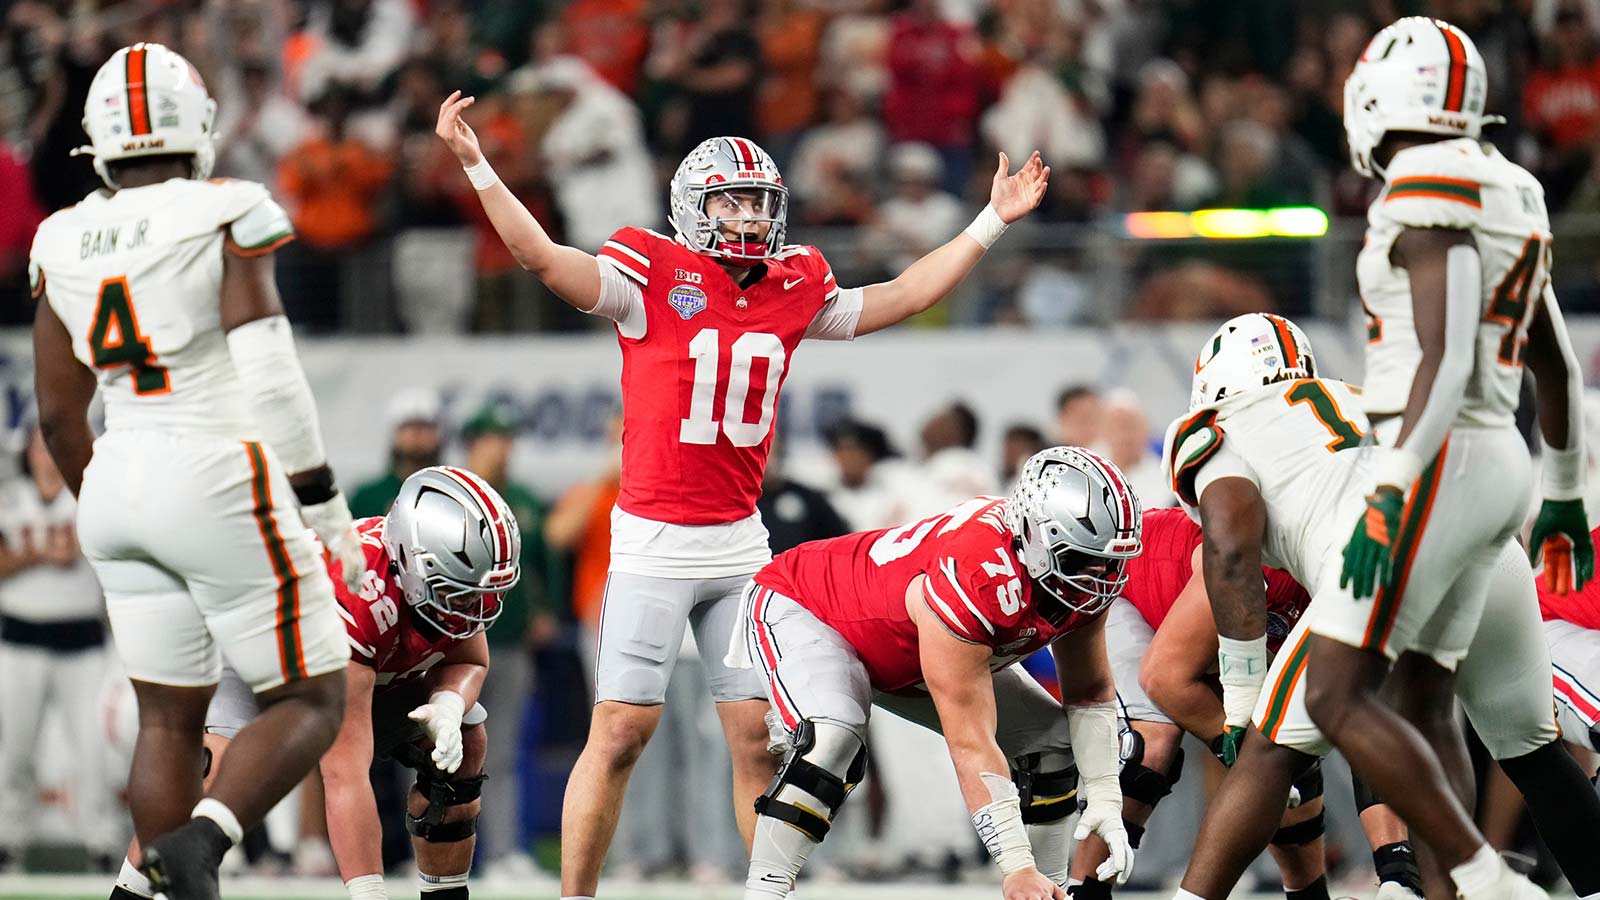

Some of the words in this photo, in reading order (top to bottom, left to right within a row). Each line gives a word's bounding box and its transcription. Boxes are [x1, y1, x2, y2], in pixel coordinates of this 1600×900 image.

[122, 138, 165, 151] MIAMI
[1428, 115, 1467, 130] MIAMI
[80, 228, 121, 260] BAIN
[87, 273, 173, 397] 4
[679, 327, 786, 448] 10
[358, 569, 399, 636] 62
[980, 546, 1027, 617] 75
